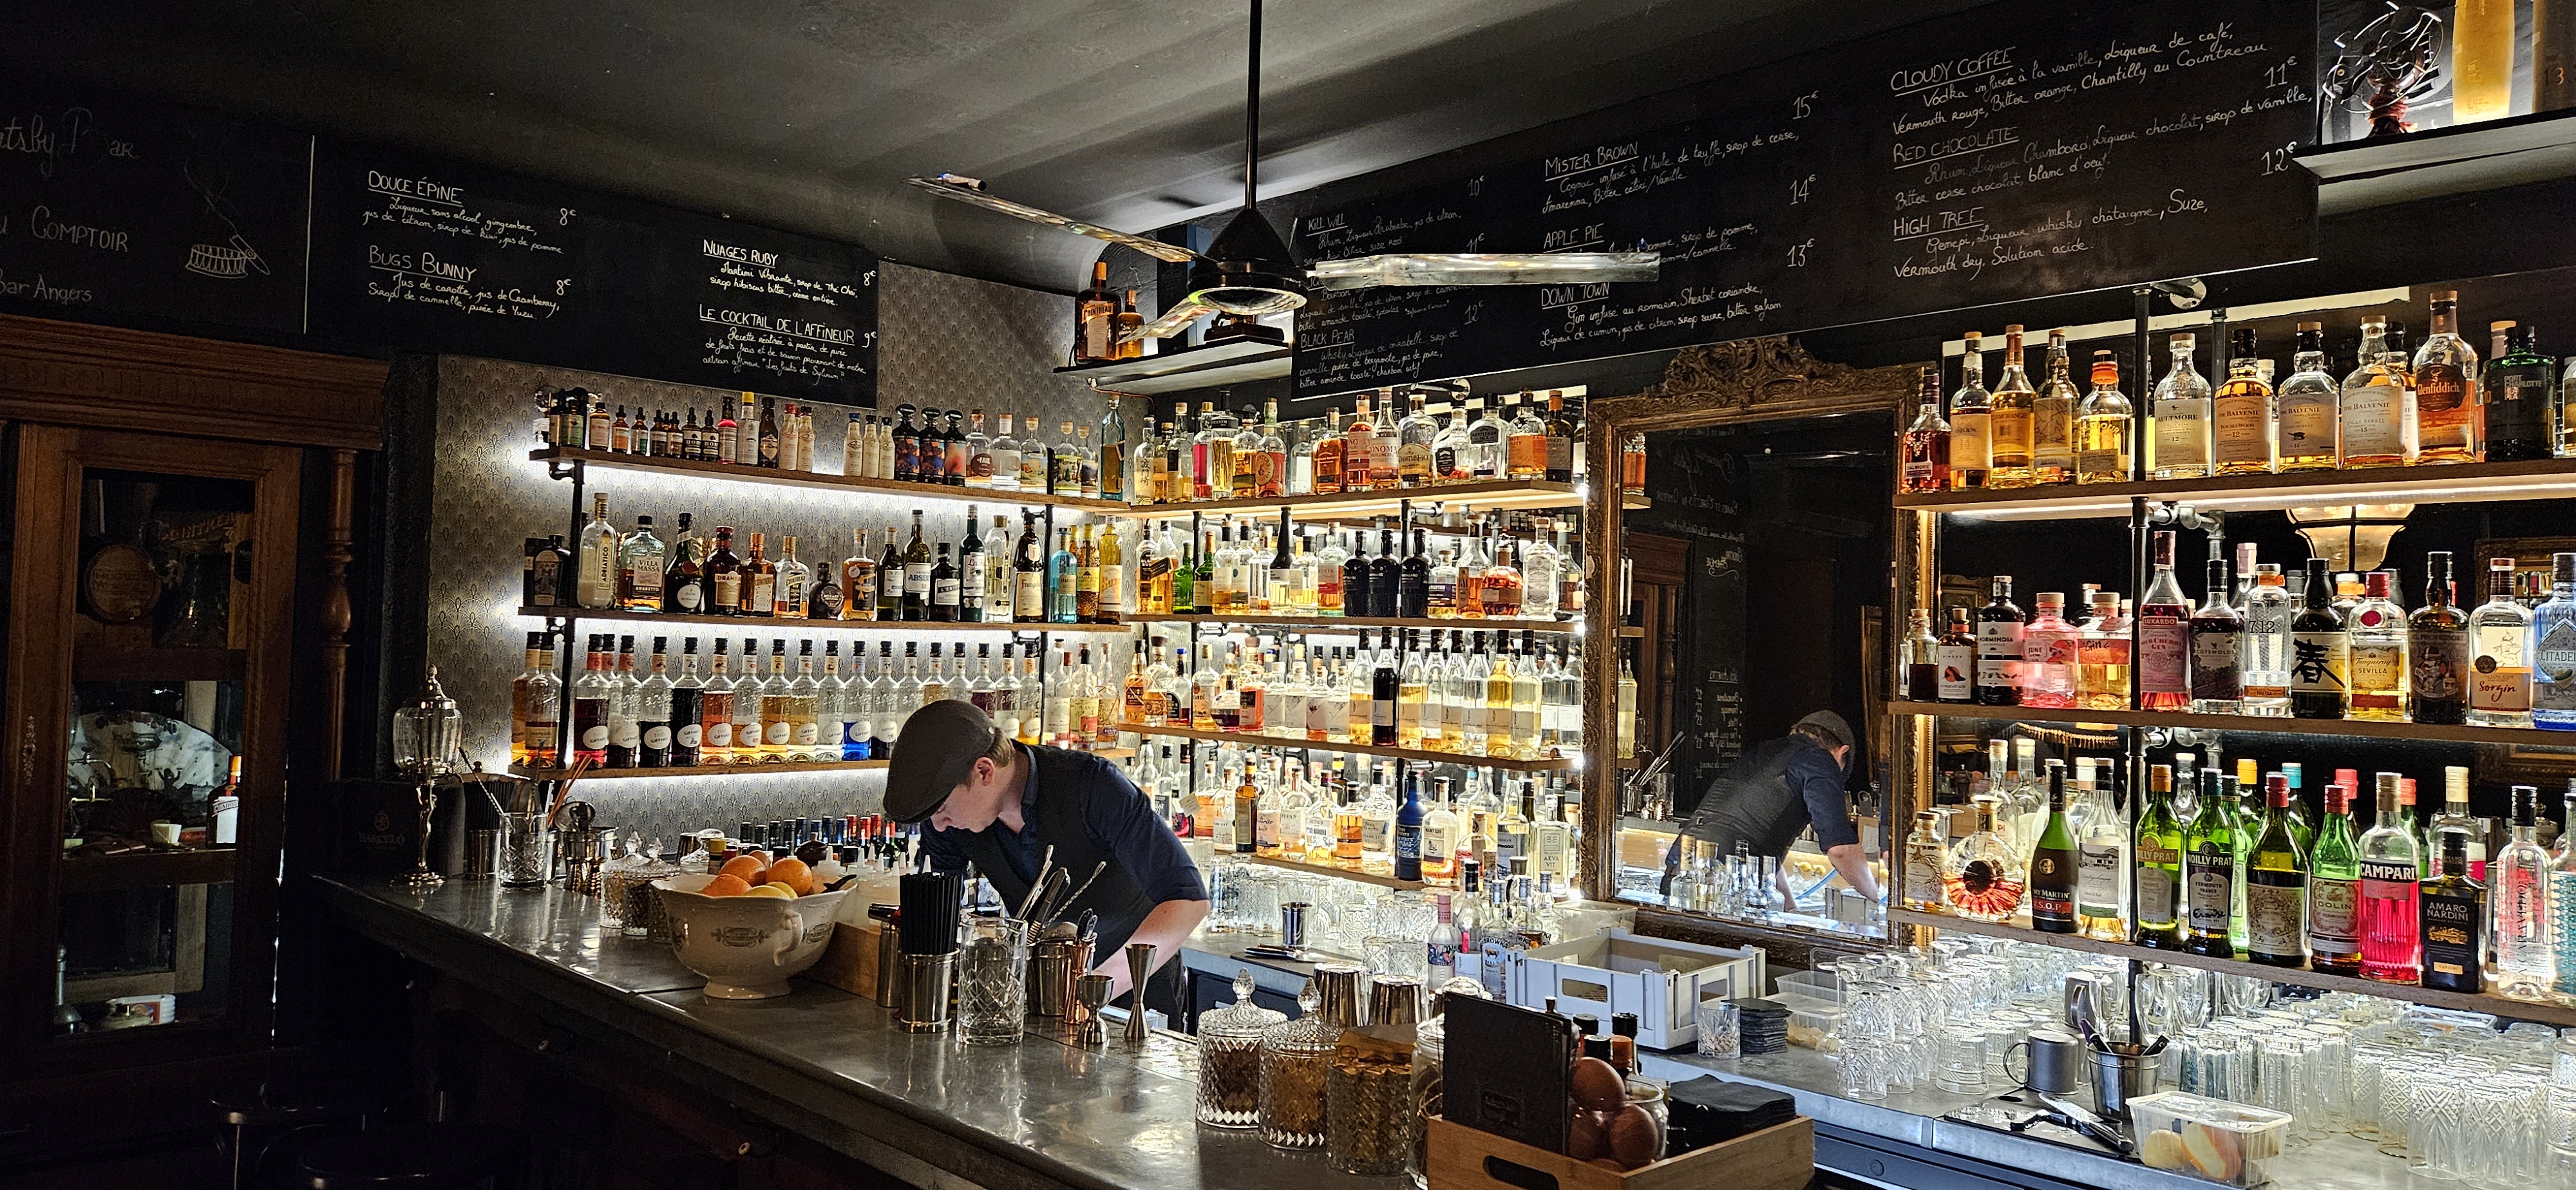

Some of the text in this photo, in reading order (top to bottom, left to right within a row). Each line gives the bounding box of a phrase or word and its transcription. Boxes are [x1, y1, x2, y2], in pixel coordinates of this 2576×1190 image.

[1889, 46, 2016, 91] CLOUDY COFFEE
[2264, 57, 2297, 89] 11€
[1792, 90, 1819, 119] 15€
[1893, 111, 1947, 135] Vermouth
[2081, 59, 2146, 90] Chantilly
[1922, 86, 1969, 107] Vodka
[2206, 108, 2236, 124] sirop
[1598, 142, 1639, 164] BROWN
[1893, 126, 2018, 163] RED CHOCOLATE
[2261, 142, 2297, 176] 12€
[368, 170, 412, 193] DOUCE
[2029, 167, 2064, 182] blanc
[1560, 175, 1594, 197] Cognac
[1790, 174, 1816, 205] 14€
[32, 205, 128, 252] COMPTOIR
[1939, 207, 1984, 228] TREE
[1544, 228, 1578, 249] APPLE
[369, 245, 477, 281] BUGS BUNNY
[703, 239, 778, 267] NUAGES RUBY
[1787, 238, 1815, 267] 13€
[1893, 261, 1956, 279] Vermouth
[1991, 244, 2044, 266] Solution
[33, 274, 91, 305] Angers
[1542, 283, 1609, 307] DOWN TOWN
[699, 304, 715, 319] LE
[777, 318, 791, 332] DE
[1301, 329, 1354, 348] BLACK PEAR
[2417, 383, 2460, 396] Glenfiddich
[2248, 621, 2275, 634] 7.12
[2479, 681, 2517, 702] Sorgin
[2154, 851, 2175, 862] PRAT
[2212, 856, 2232, 866] PRAT
[2360, 864, 2416, 880] CAMPARI
[2041, 889, 2069, 899] MARTIN
[2427, 909, 2468, 921] NARDINI
[2429, 902, 2467, 912] AMARO
